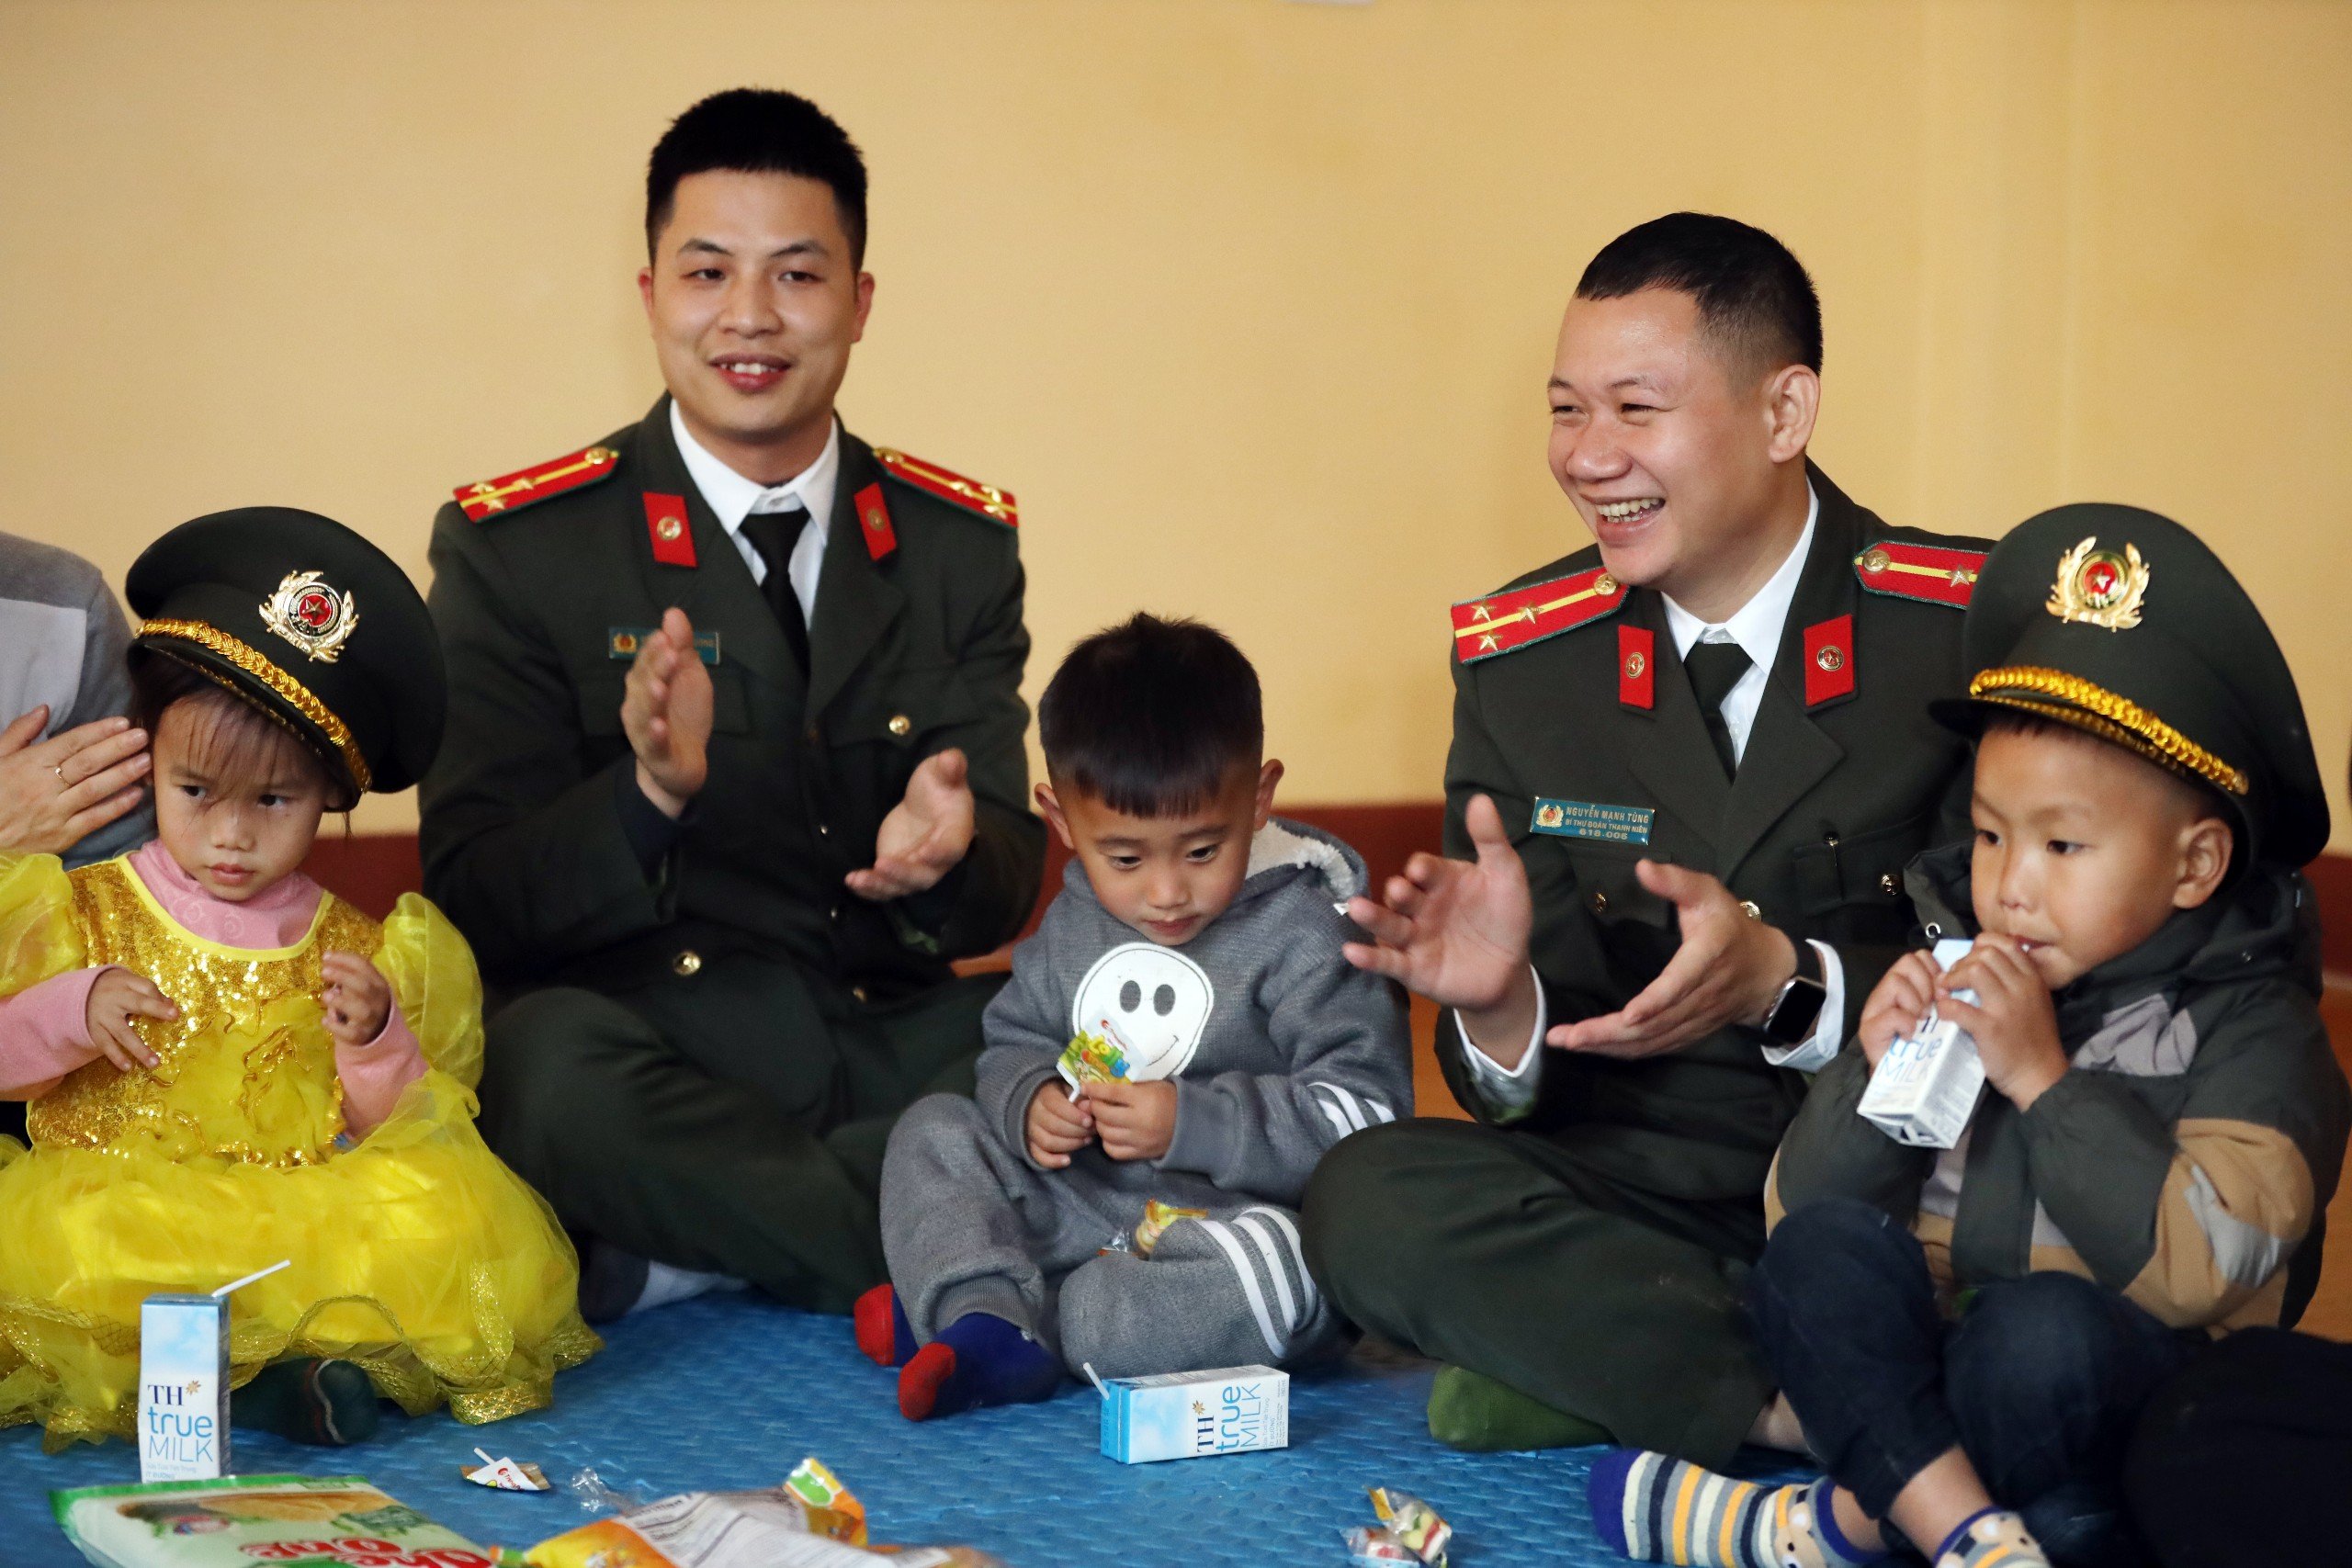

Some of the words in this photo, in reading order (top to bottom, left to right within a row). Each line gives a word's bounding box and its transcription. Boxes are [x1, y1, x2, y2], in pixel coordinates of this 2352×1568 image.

[1566, 805, 1600, 818] NGUYỄN
[1601, 810, 1625, 822] MẠNH
[1627, 811, 1649, 824] TÙNG
[1609, 823, 1631, 832] THANH
[1631, 825, 1648, 834] NIÊN
[1890, 1033, 1942, 1062] true
[147, 1384, 184, 1406] TH
[147, 1405, 213, 1438] true
[1216, 1385, 1241, 1452] true
[1240, 1382, 1261, 1448] MILK
[1196, 1415, 1215, 1453] TH
[148, 1436, 214, 1462] MILK
